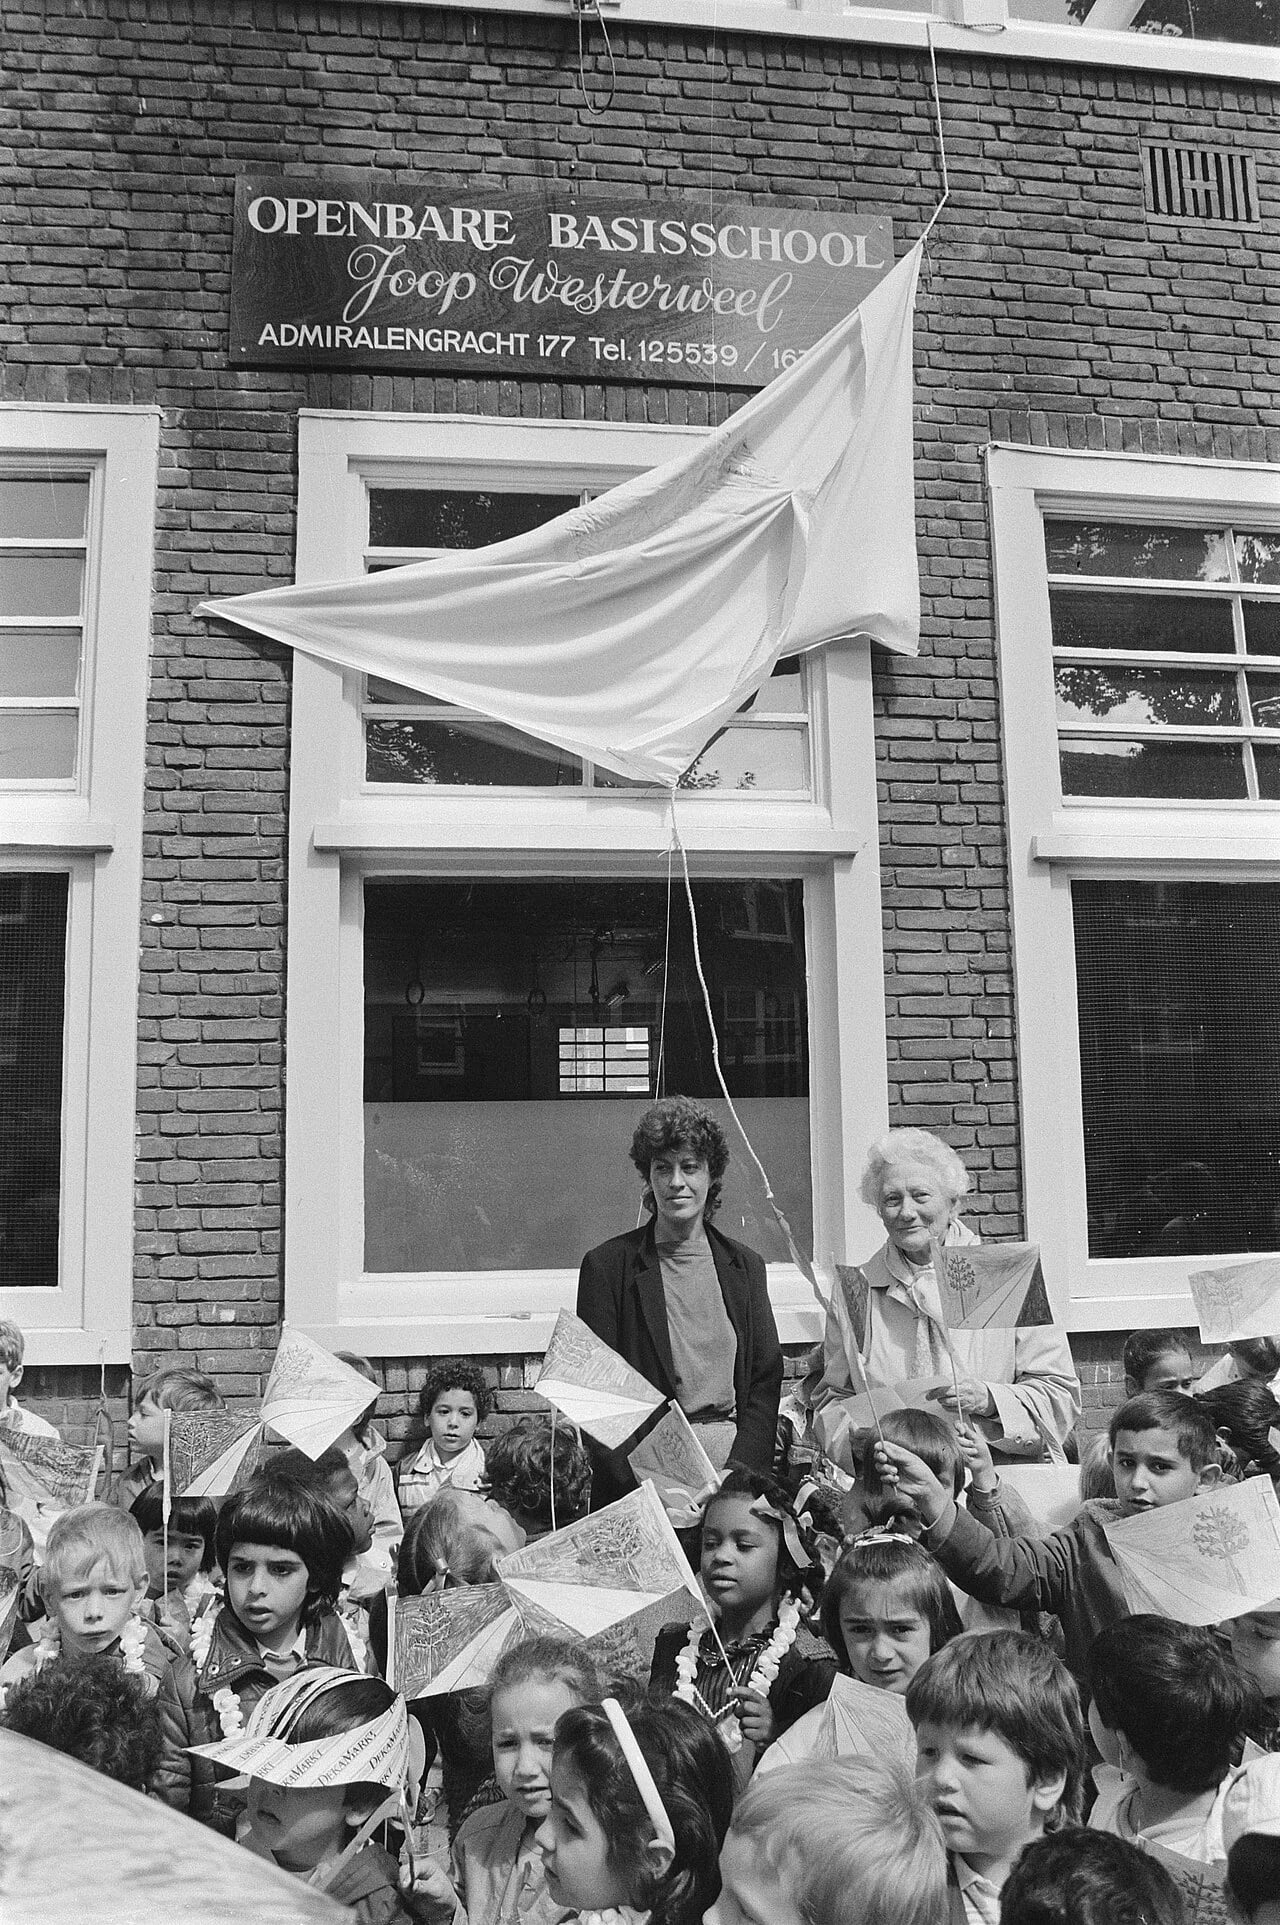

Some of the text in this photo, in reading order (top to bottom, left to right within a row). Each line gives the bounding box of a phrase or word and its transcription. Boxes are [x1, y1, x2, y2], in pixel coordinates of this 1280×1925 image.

[247, 196, 885, 269] OPENBARE BASISSCHOOL
[342, 243, 793, 333] Joop Westerweel
[258, 323, 530, 356] ADMIRALENGRACHT
[537, 334, 576, 357] 177
[589, 337, 632, 361] Tel.
[638, 339, 738, 367] 125539
[771, 348, 809, 369] 16
